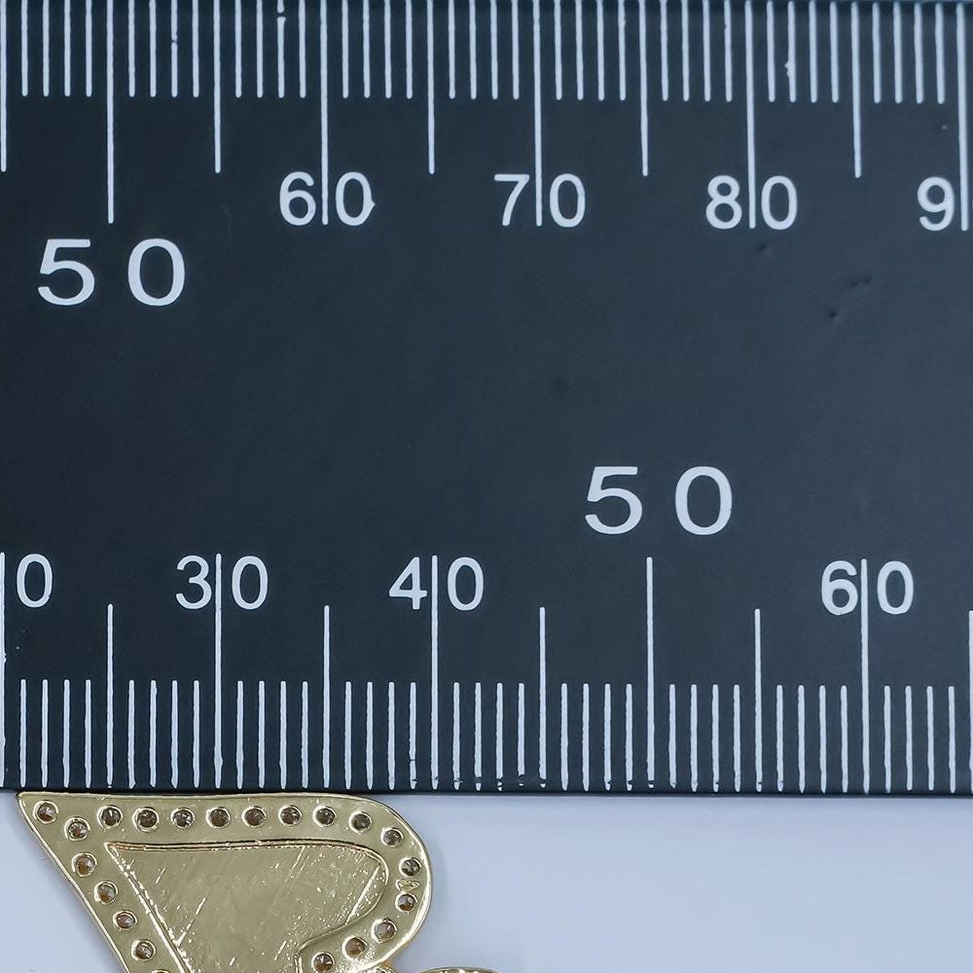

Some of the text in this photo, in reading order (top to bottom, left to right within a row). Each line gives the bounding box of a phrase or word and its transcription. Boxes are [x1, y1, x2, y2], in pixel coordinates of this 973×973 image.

[280, 172, 375, 226] 60
[494, 174, 585, 227] 70
[706, 175, 797, 230] 80
[38, 238, 185, 306] 50
[585, 466, 733, 535] 50
[176, 555, 268, 609] 30
[389, 557, 483, 610] 40
[821, 561, 914, 615] 60
